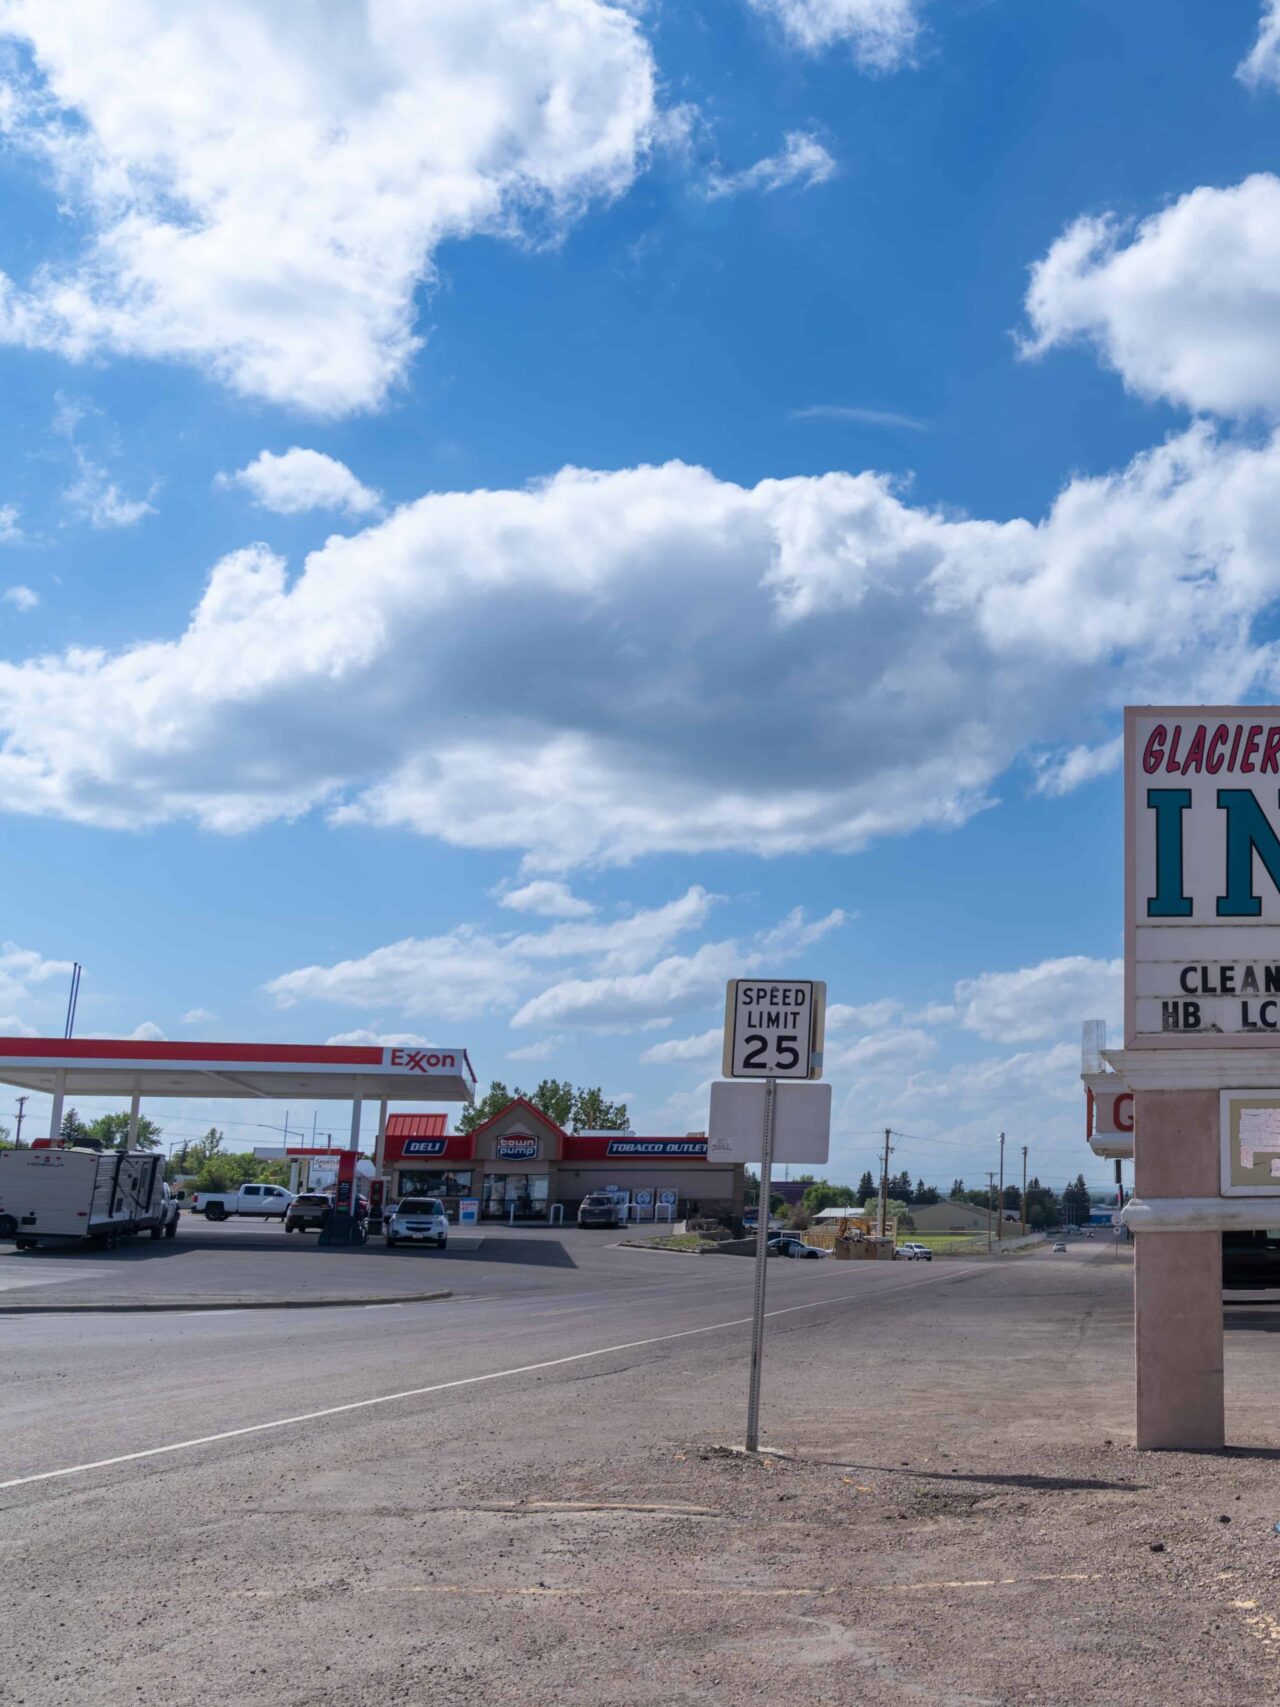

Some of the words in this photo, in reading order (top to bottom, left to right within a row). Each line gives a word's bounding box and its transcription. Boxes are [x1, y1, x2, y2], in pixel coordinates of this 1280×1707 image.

[742, 987, 806, 1006] SPEED
[747, 1011, 800, 1029] LIMIT
[742, 1034, 800, 1070] 25
[390, 1048, 456, 1073] Exxon
[409, 1142, 441, 1151] DELI
[500, 1139, 534, 1147] town
[611, 1143, 663, 1152] TOBACCO
[666, 1143, 708, 1152] OUTLET
[500, 1147, 534, 1155] pump
